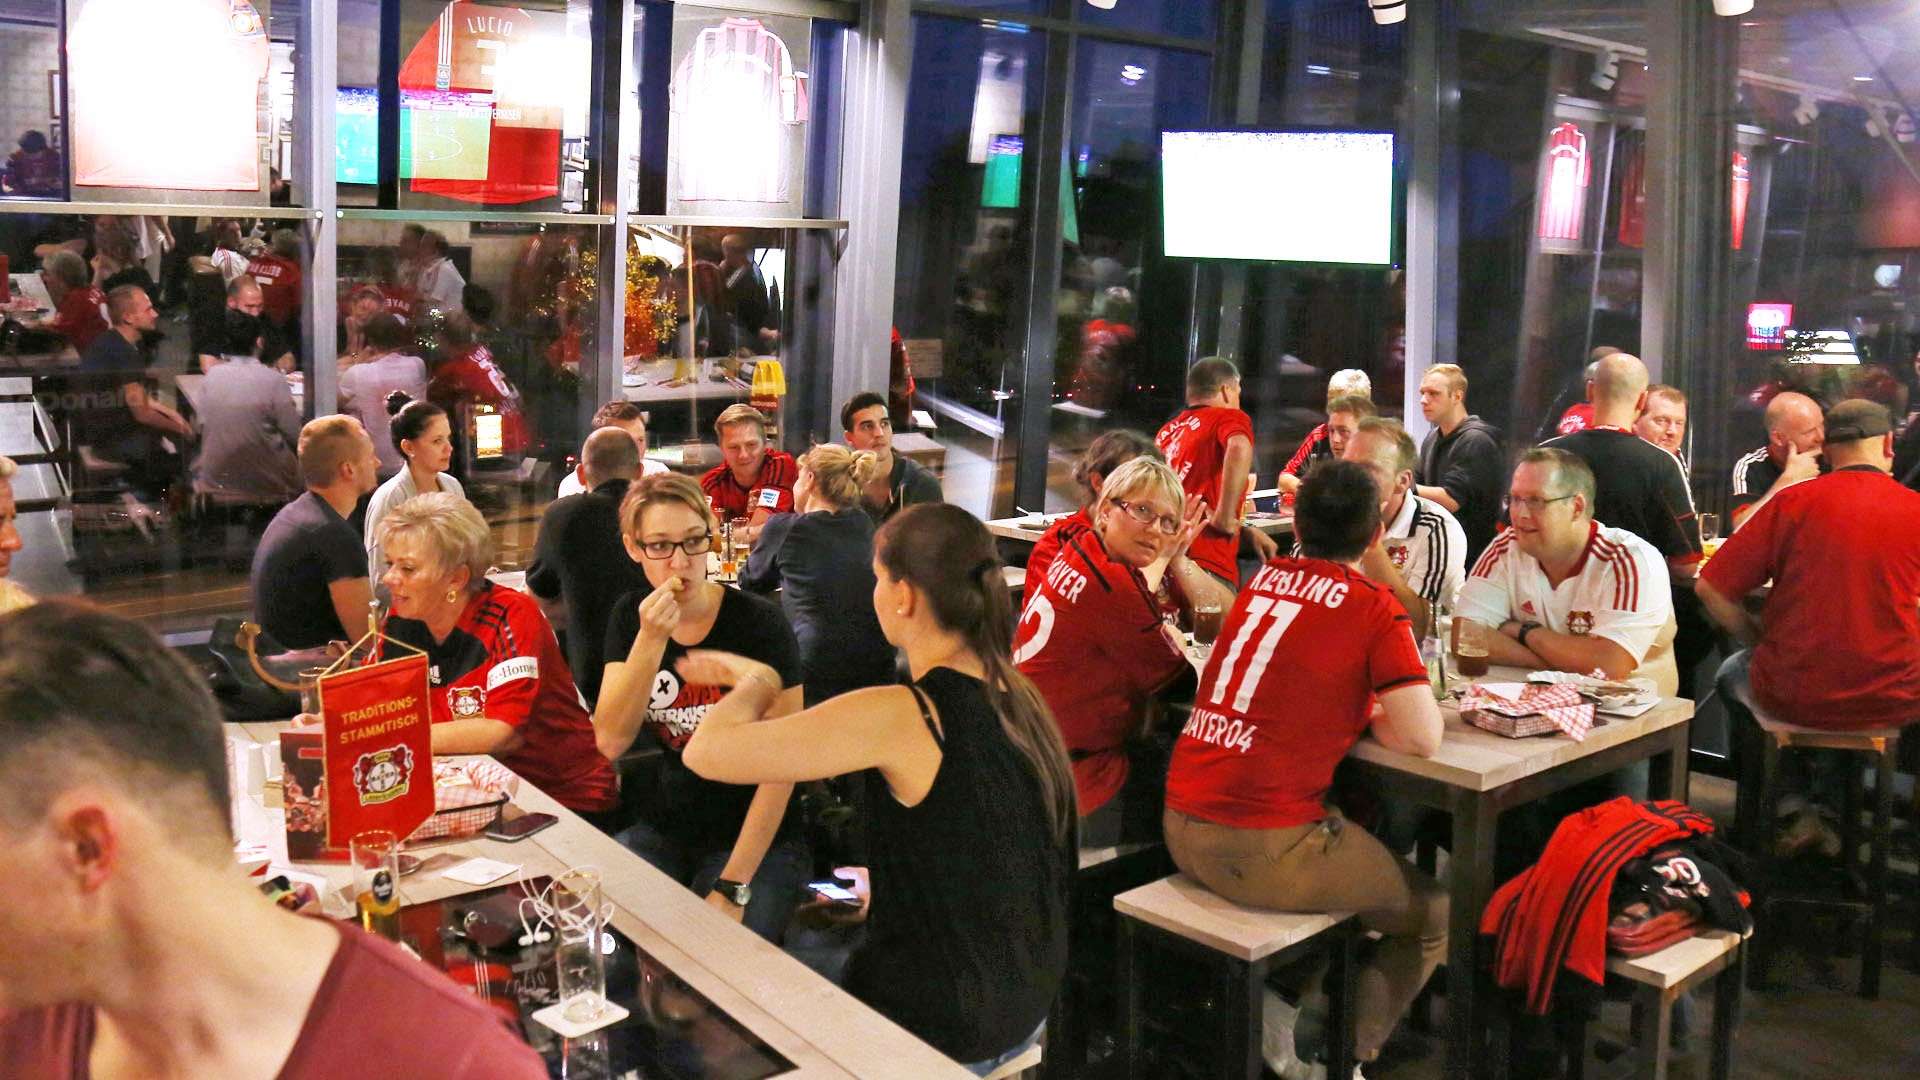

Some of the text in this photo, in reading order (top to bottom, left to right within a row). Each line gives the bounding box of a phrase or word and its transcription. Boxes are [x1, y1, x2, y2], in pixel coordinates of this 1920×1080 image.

[467, 16, 513, 37] LUCIO
[1210, 594, 1304, 714] 11
[340, 712, 419, 745] STAMMTISCH
